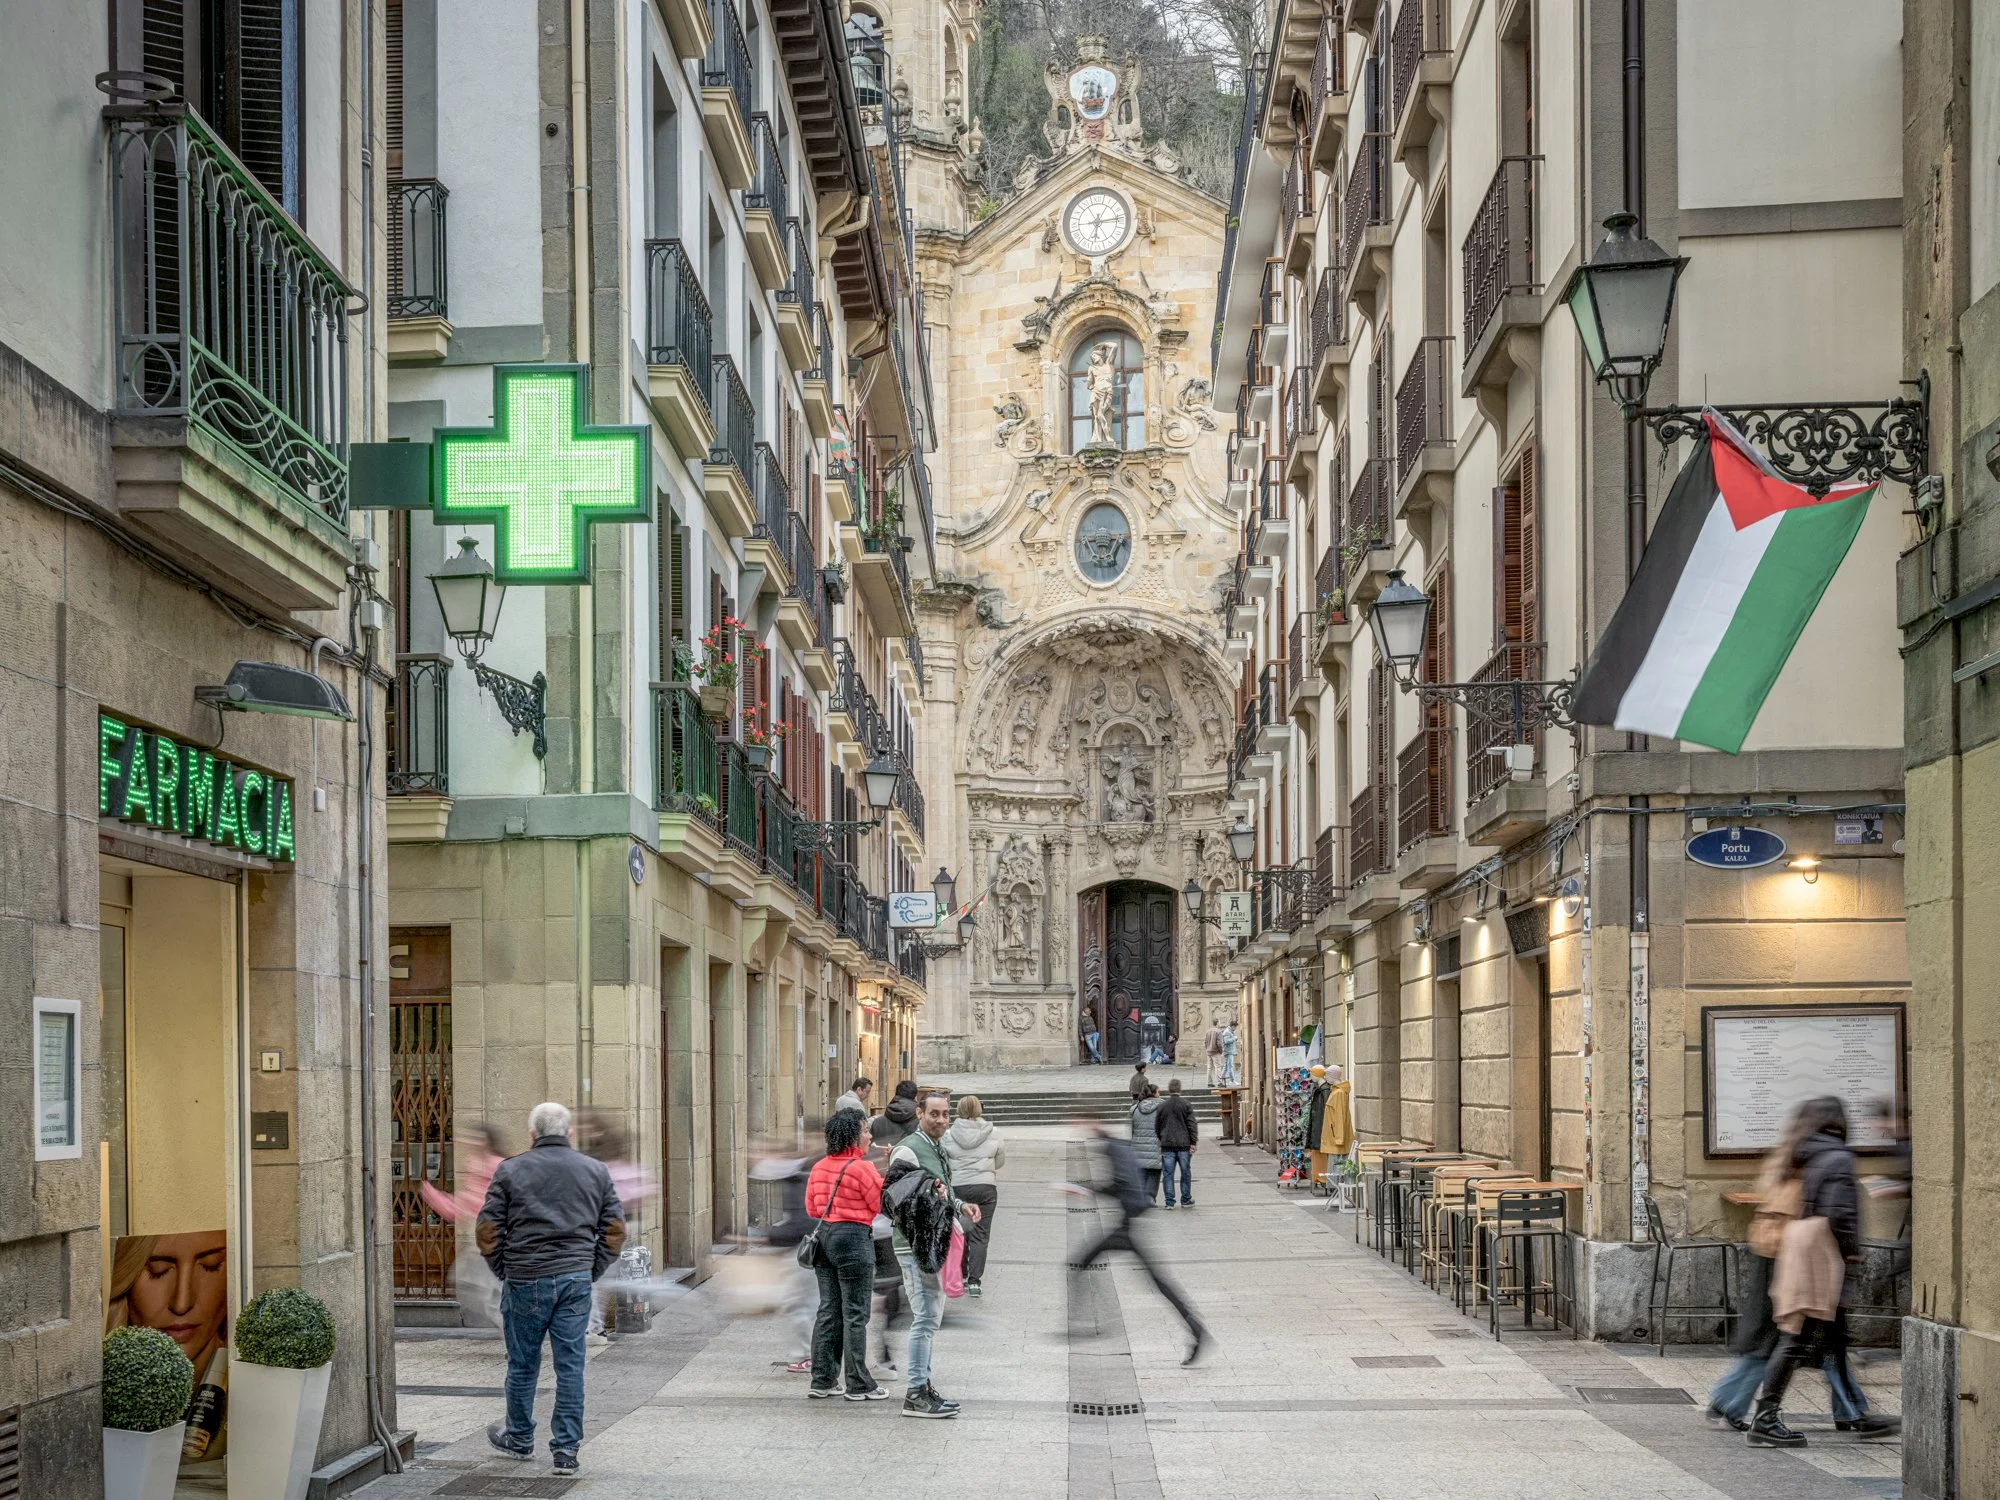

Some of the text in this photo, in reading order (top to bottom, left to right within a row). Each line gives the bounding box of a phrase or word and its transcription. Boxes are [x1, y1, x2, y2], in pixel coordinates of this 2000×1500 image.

[100, 714, 295, 862] FARMACIA
[1837, 812, 1881, 820] KONEKTATUA
[1721, 843, 1751, 853] Portu
